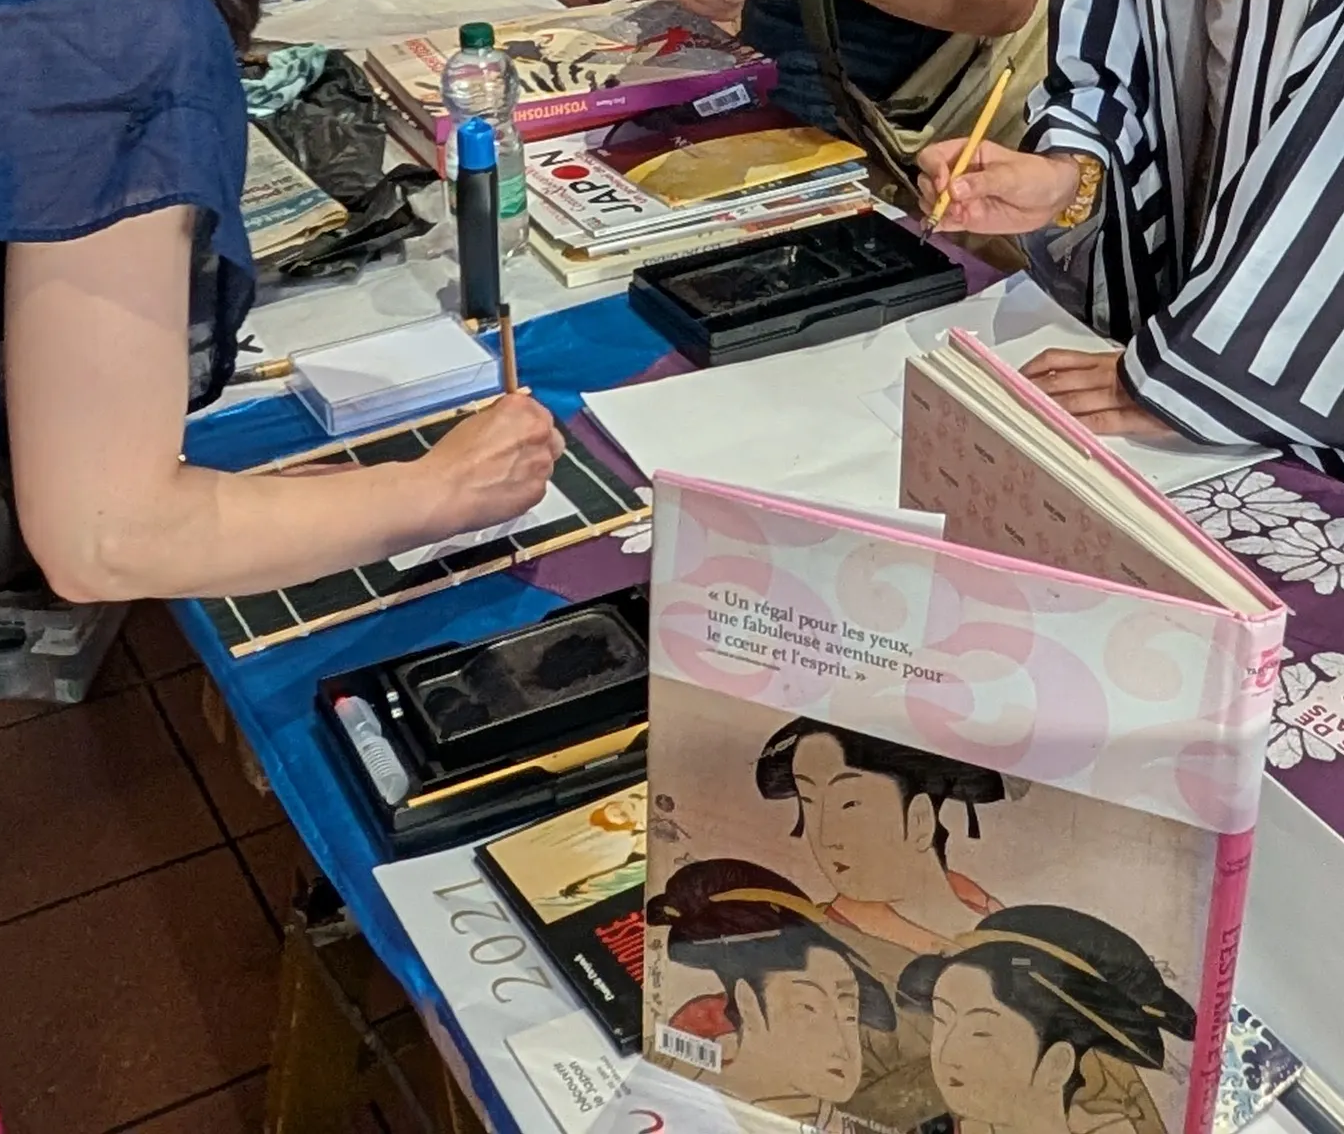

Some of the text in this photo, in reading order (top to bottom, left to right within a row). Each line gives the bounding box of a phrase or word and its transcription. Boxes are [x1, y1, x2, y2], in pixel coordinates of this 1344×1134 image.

[513, 100, 589, 122] YOSHITOSHI
[708, 609, 944, 684] une fabuleuse aventure pour
[725, 591, 749, 610] Un
[755, 600, 794, 623] régal
[798, 614, 838, 635] pour
[842, 622, 865, 642] les
[870, 633, 913, 657] yeux,
[707, 625, 721, 643] le
[725, 635, 768, 656] cœur
[772, 647, 787, 662] et
[791, 649, 851, 679] l'esprit.
[1294, 712, 1334, 737] DE
[432, 877, 554, 1004] 2021
[569, 1060, 599, 1093] Japon
